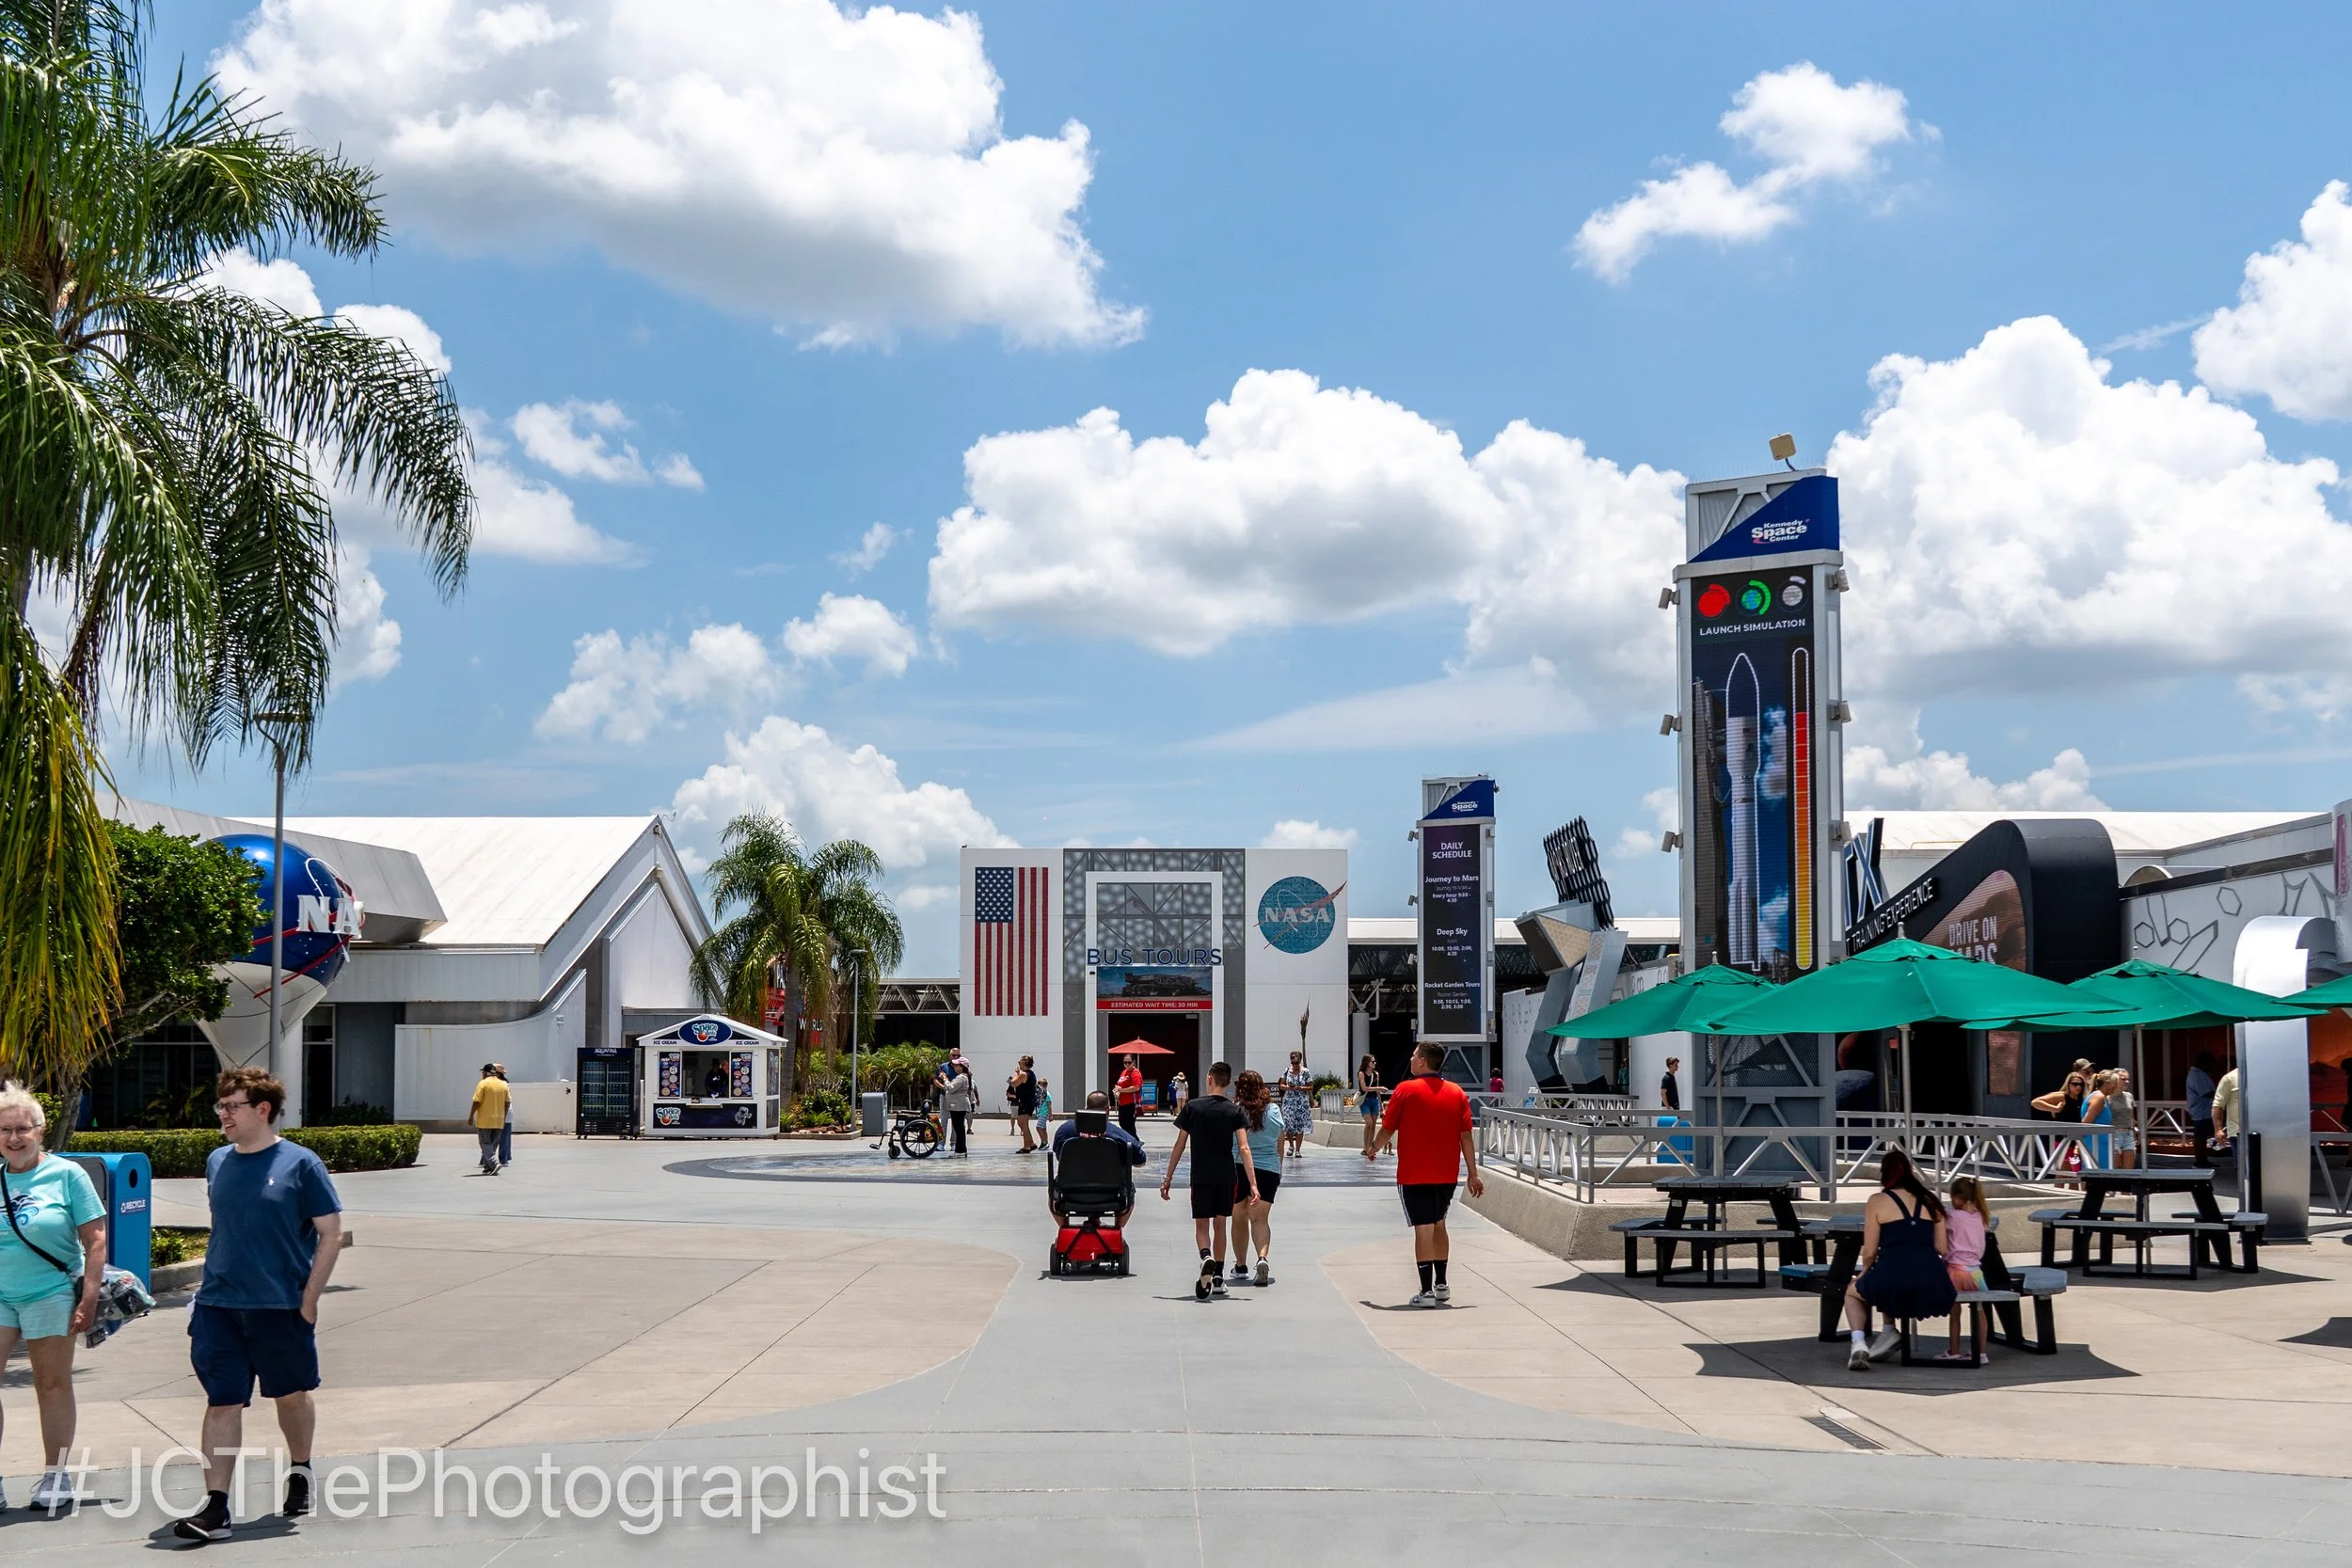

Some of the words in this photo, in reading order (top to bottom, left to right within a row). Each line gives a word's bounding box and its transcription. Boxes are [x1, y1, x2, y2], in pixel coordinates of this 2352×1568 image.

[1763, 519, 1804, 529] Kennedy
[1751, 525, 1807, 540] Space
[1699, 625, 1741, 636] LAUNCH
[1742, 619, 1806, 632] SIMULATION
[1440, 841, 1464, 850] DAILY
[1432, 849, 1473, 860] SCHEDULE
[1424, 876, 1452, 884] Journey
[1263, 907, 1331, 923] NASA
[1851, 913, 1885, 952] TRAINING
[1885, 878, 1933, 928] EXPERIENCE
[1437, 928, 1454, 937] Deep
[1455, 927, 1468, 936] Sky
[1948, 919, 1979, 946] DRIVE
[1981, 916, 1997, 941] ON
[1087, 948, 1133, 965] BUS
[1142, 948, 1222, 966] TOURS
[126, 1199, 147, 1209] RECYCLE
